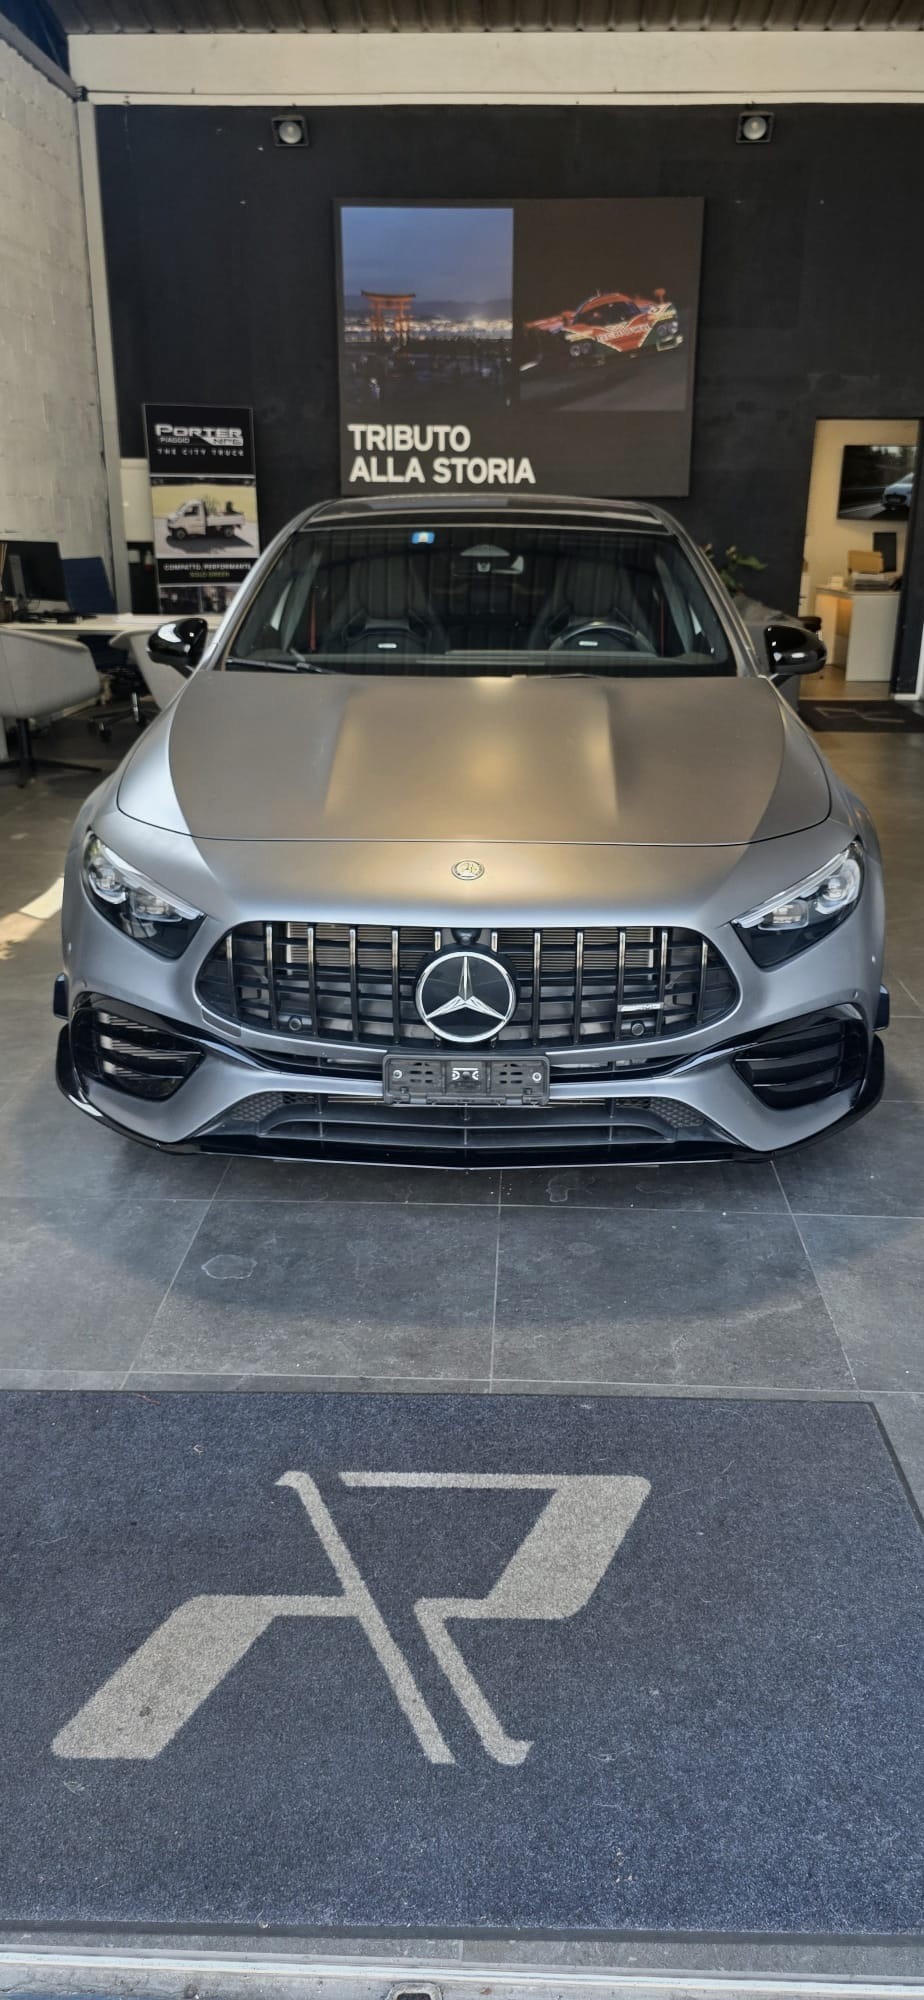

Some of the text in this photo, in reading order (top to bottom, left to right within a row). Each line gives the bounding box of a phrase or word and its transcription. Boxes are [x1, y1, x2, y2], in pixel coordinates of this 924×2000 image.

[155, 423, 242, 437] PORTER
[160, 436, 190, 444] PIAGGIO
[348, 424, 471, 452] TRIBUTO
[182, 448, 207, 456] CITY
[211, 448, 244, 457] TRUCK
[349, 456, 536, 484] ALLA STORIA
